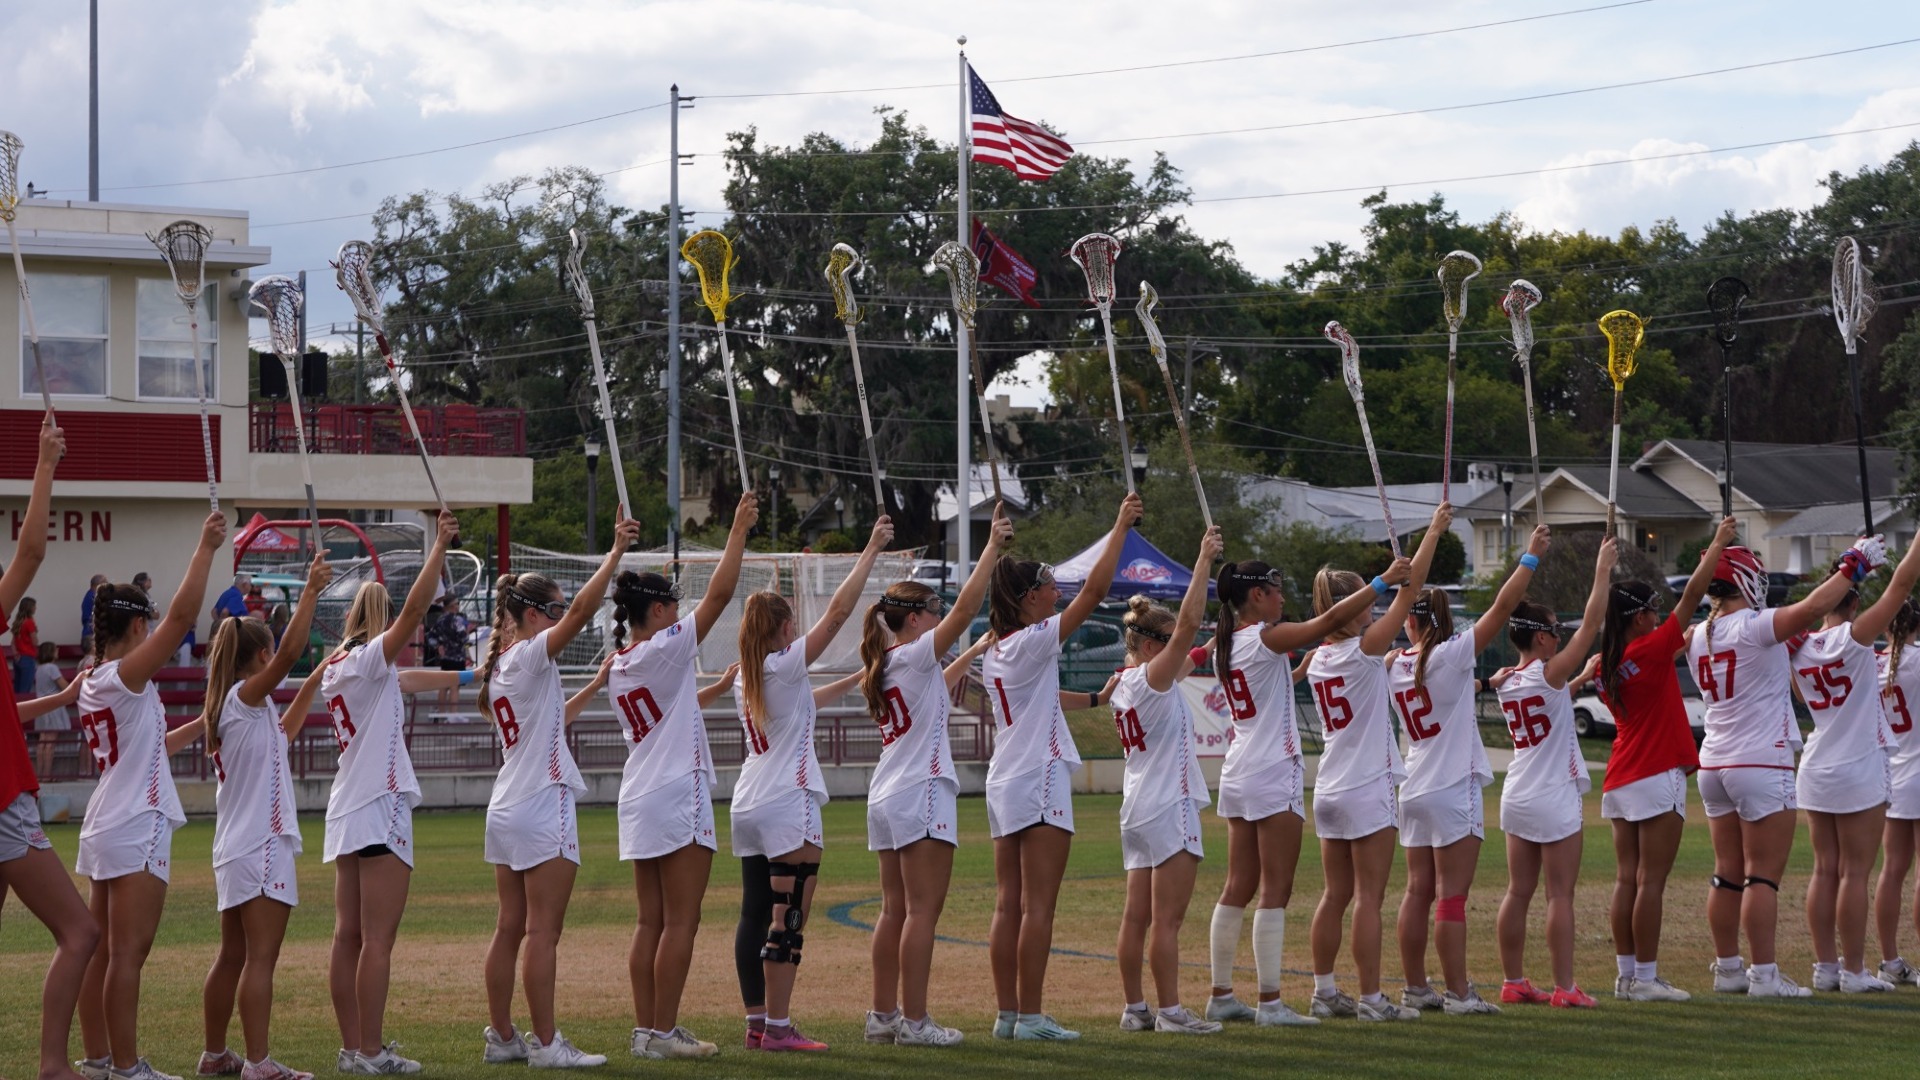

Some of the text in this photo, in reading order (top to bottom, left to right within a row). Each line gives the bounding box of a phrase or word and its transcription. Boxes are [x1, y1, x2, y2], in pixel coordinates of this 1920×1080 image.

[0, 510, 112, 541] HERN
[1697, 649, 1737, 702] 47
[1798, 659, 1853, 711] 35
[493, 696, 519, 749] 8
[617, 687, 663, 743] 10
[994, 678, 1013, 727] 1
[1314, 676, 1353, 732] 15
[1395, 685, 1441, 741] 12
[1502, 695, 1552, 749] 26
[1879, 685, 1913, 734] 3
[1115, 707, 1147, 756] 44
[1207, 734, 1222, 747] go
